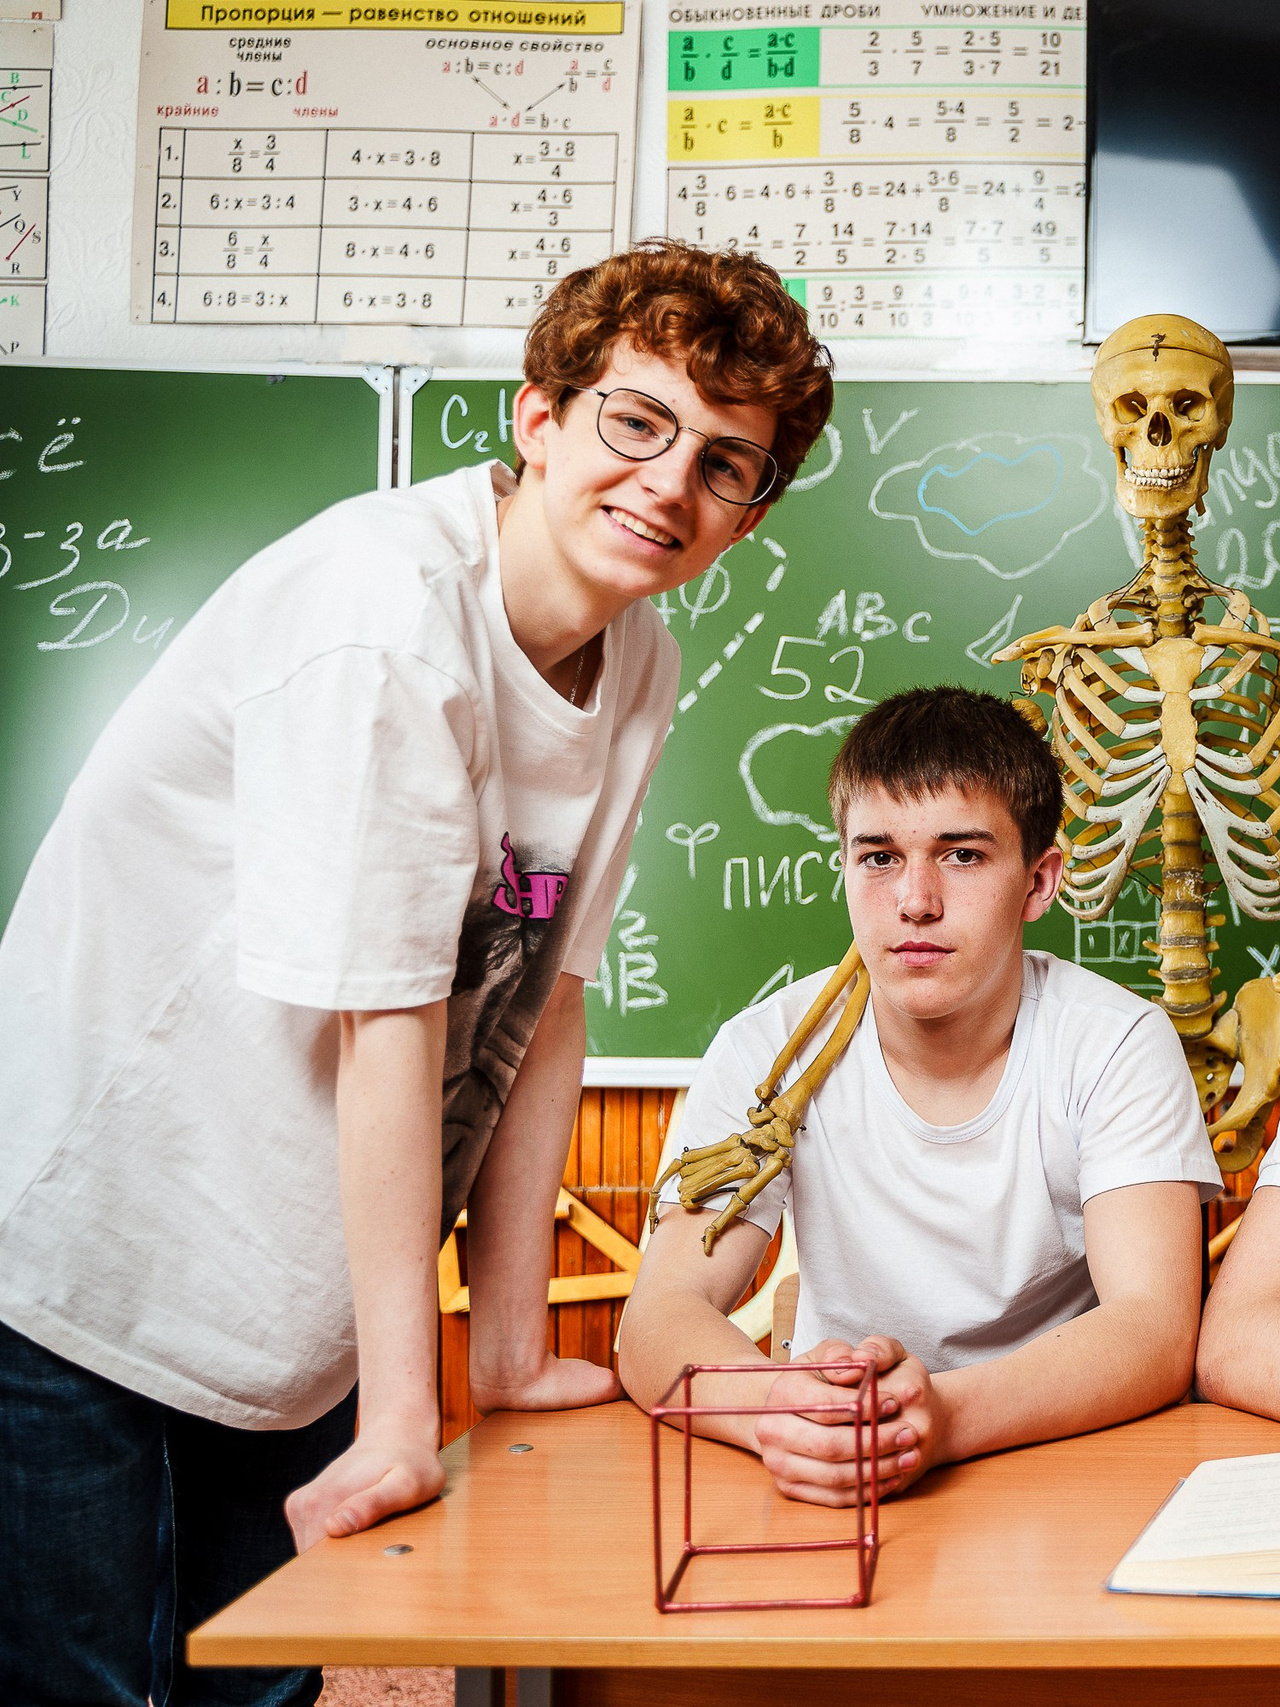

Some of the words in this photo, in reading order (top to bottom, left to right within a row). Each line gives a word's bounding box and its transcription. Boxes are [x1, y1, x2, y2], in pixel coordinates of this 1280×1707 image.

[201, 5, 315, 24] Пропорция
[350, 7, 459, 24] равенство
[468, 9, 587, 26] отношений
[669, 5, 812, 23] ОБЫКНОВЕННЫЕ
[820, 4, 880, 19] ДРОБИ
[921, 4, 1036, 19] УМНОЖЕНИЕ
[1043, 6, 1056, 19] И
[1062, 6, 1087, 21] ДЕ
[229, 36, 292, 50] средние
[425, 38, 514, 51] основное
[519, 39, 604, 52] свойство
[1041, 32, 1061, 48] 10
[236, 52, 282, 62] члены
[1040, 61, 1060, 76] 21
[156, 103, 219, 118] крайние
[292, 106, 339, 118] члены
[164, 144, 179, 161] 1.
[161, 192, 177, 210] 2.
[158, 240, 175, 257] 3.
[157, 291, 172, 307] 4.
[755, 635, 880, 705] 52
